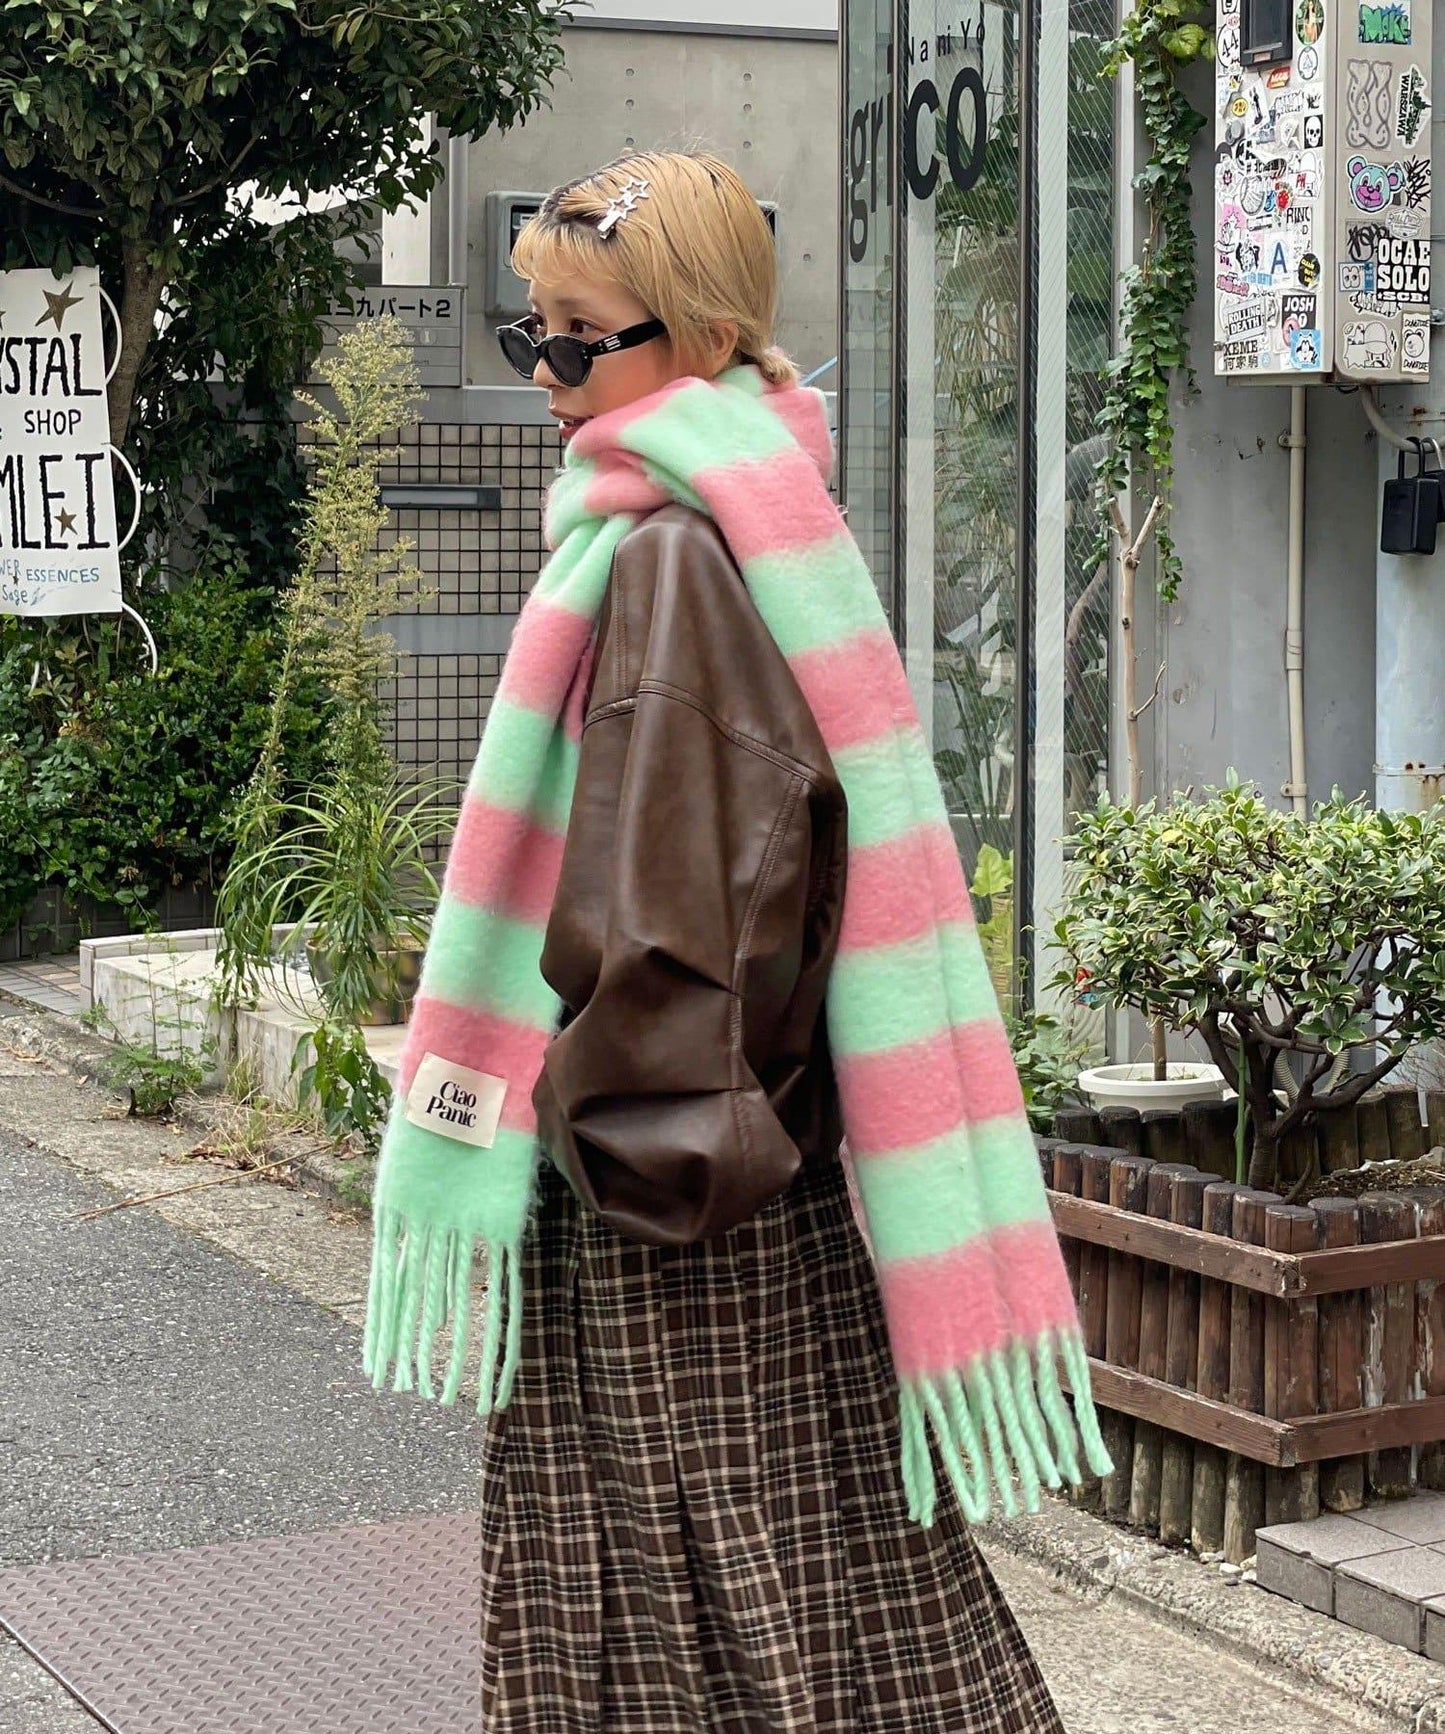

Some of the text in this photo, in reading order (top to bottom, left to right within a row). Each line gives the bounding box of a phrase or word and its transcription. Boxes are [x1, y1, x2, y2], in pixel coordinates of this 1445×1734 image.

[1377, 264, 1430, 292] SOLO
[1228, 305, 1260, 322] ROLLING
[1284, 296, 1315, 313] JOSH
[1230, 316, 1261, 335] DEATH
[1223, 340, 1258, 356] XEME
[24, 409, 81, 436] SHOP
[26, 567, 100, 583] ESSENCES
[2, 584, 28, 606] Sage
[440, 1081, 477, 1108] Ciao
[426, 1095, 477, 1128] Panic
